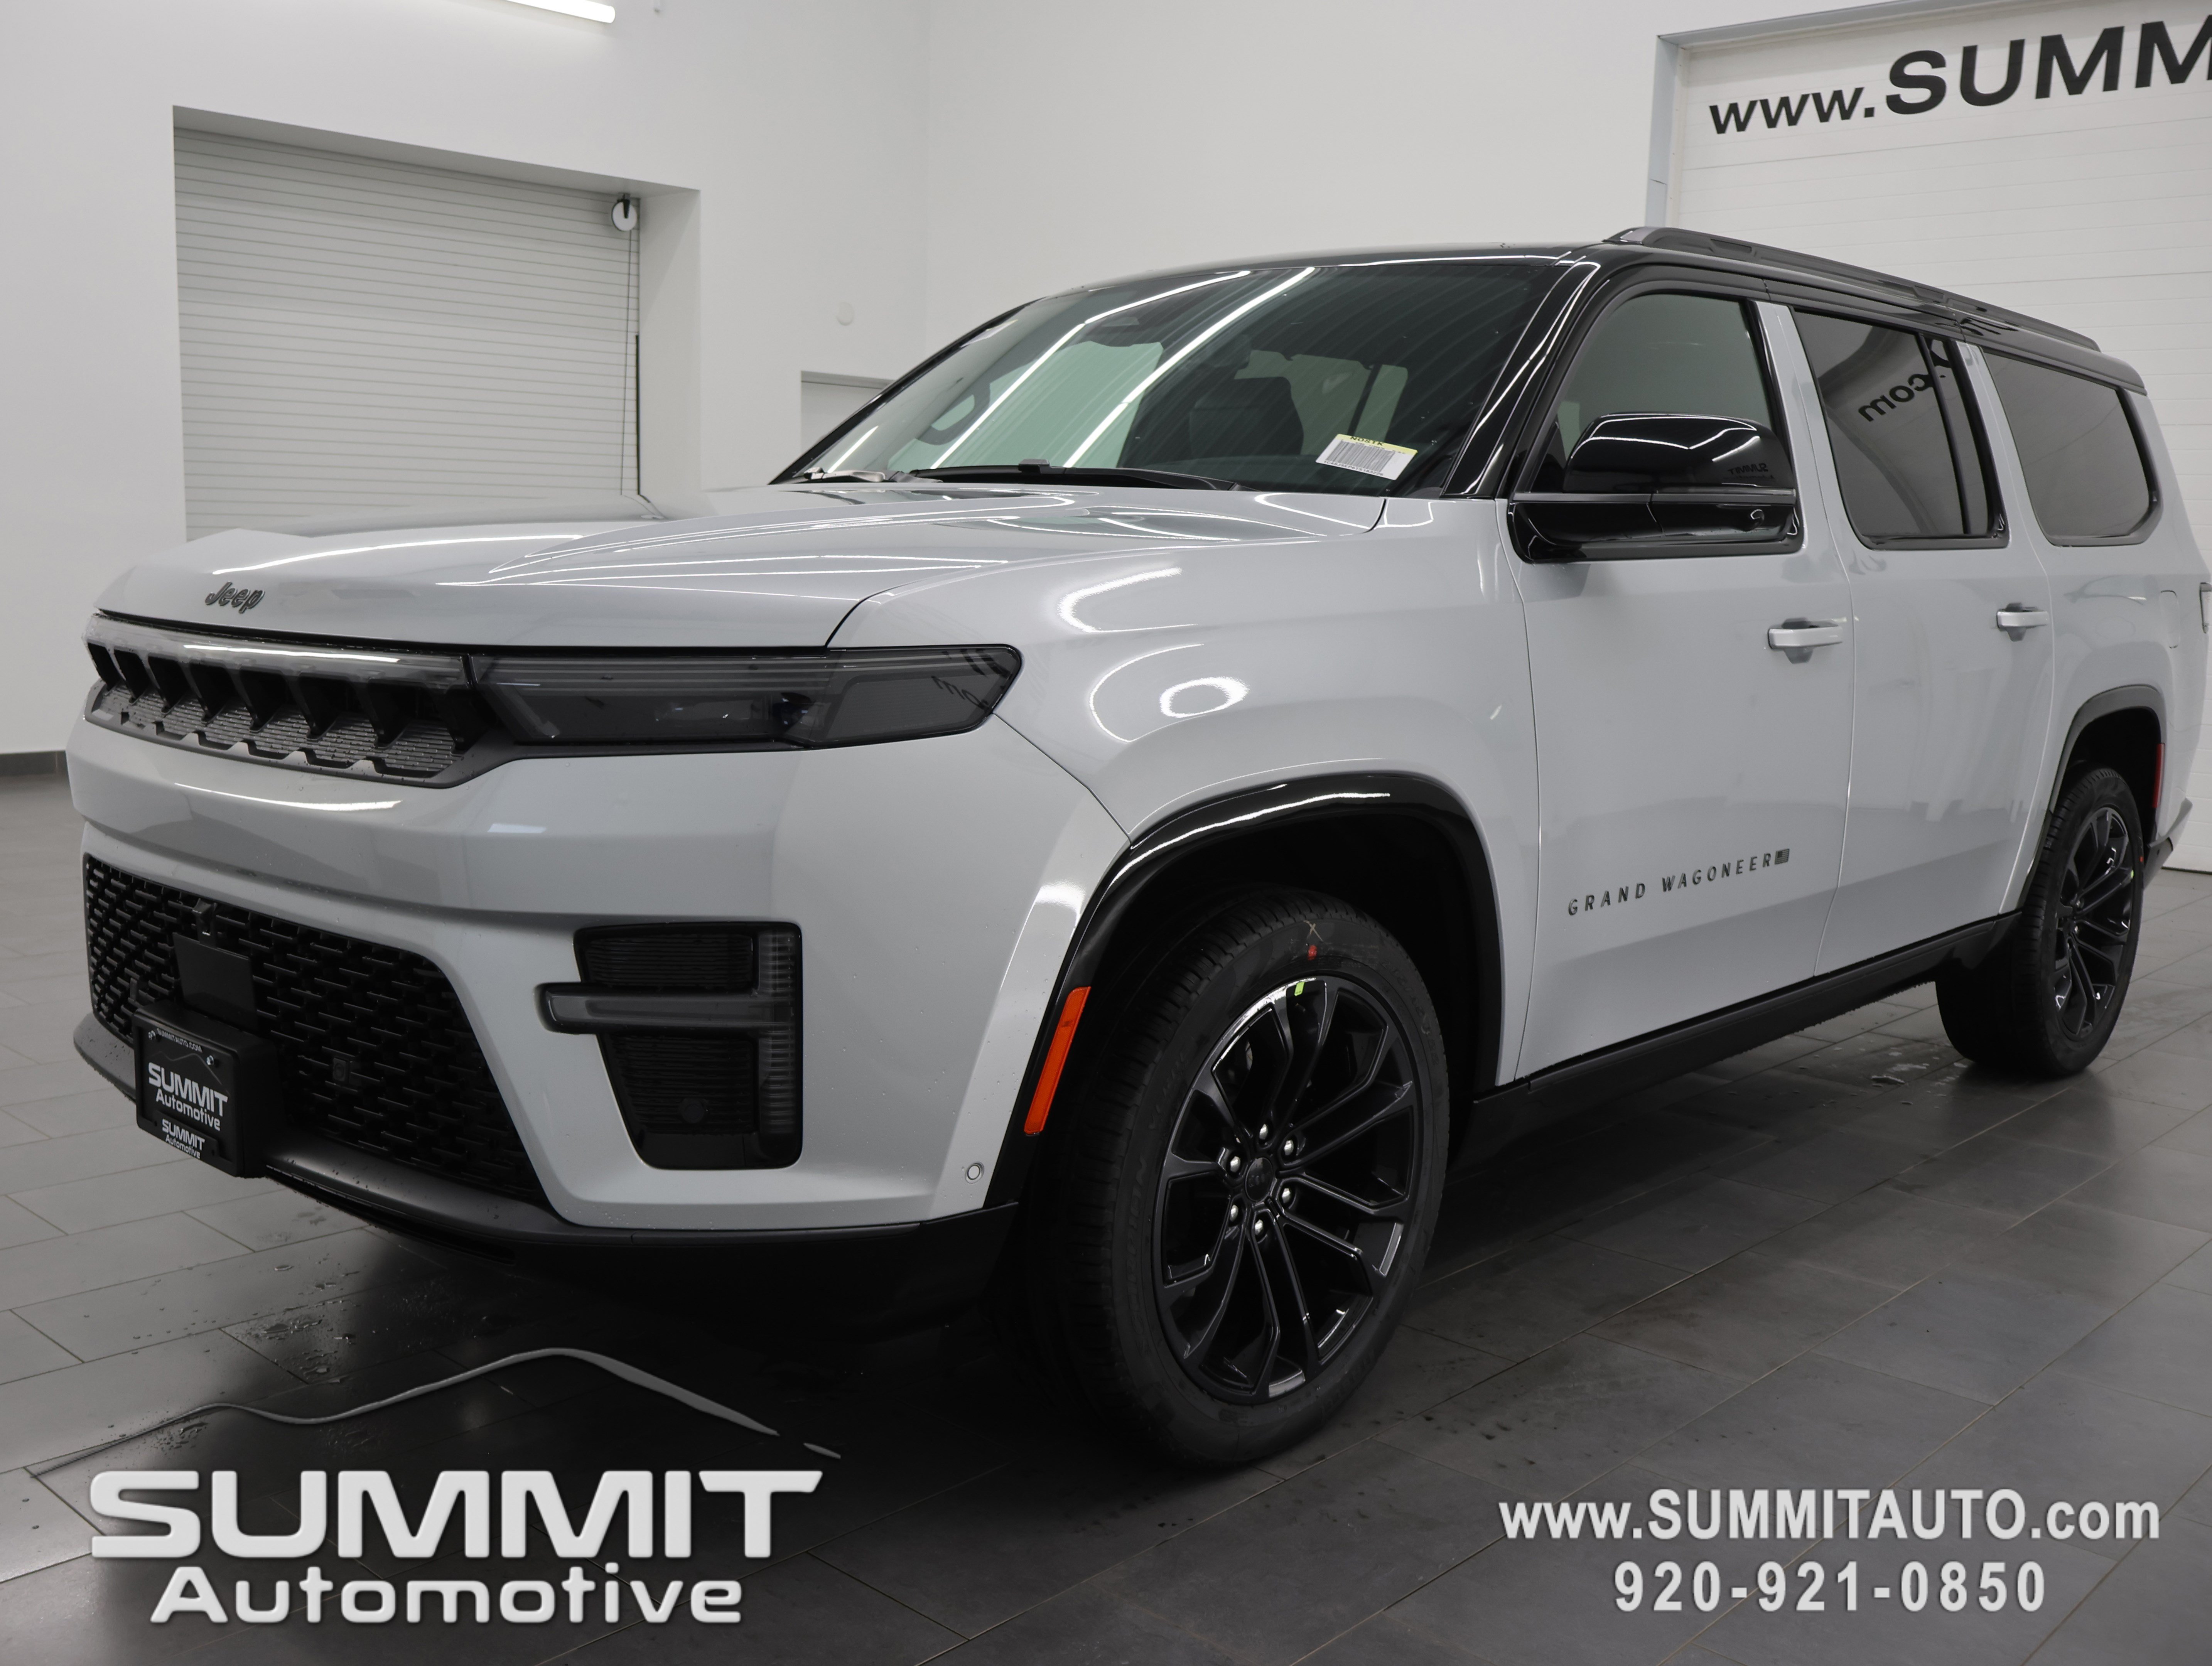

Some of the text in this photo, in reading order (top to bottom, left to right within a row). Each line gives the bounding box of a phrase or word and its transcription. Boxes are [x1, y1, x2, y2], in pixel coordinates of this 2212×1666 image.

[1350, 436, 1384, 446] NOSTK
[205, 580, 265, 614] Jeep
[1568, 853, 1772, 916] GRAND WAGONEER
[148, 1062, 228, 1117] SUMMIT
[155, 1088, 221, 1131] Automotive
[162, 1118, 205, 1151] SUMMIT
[165, 1135, 201, 1159] Automotive
